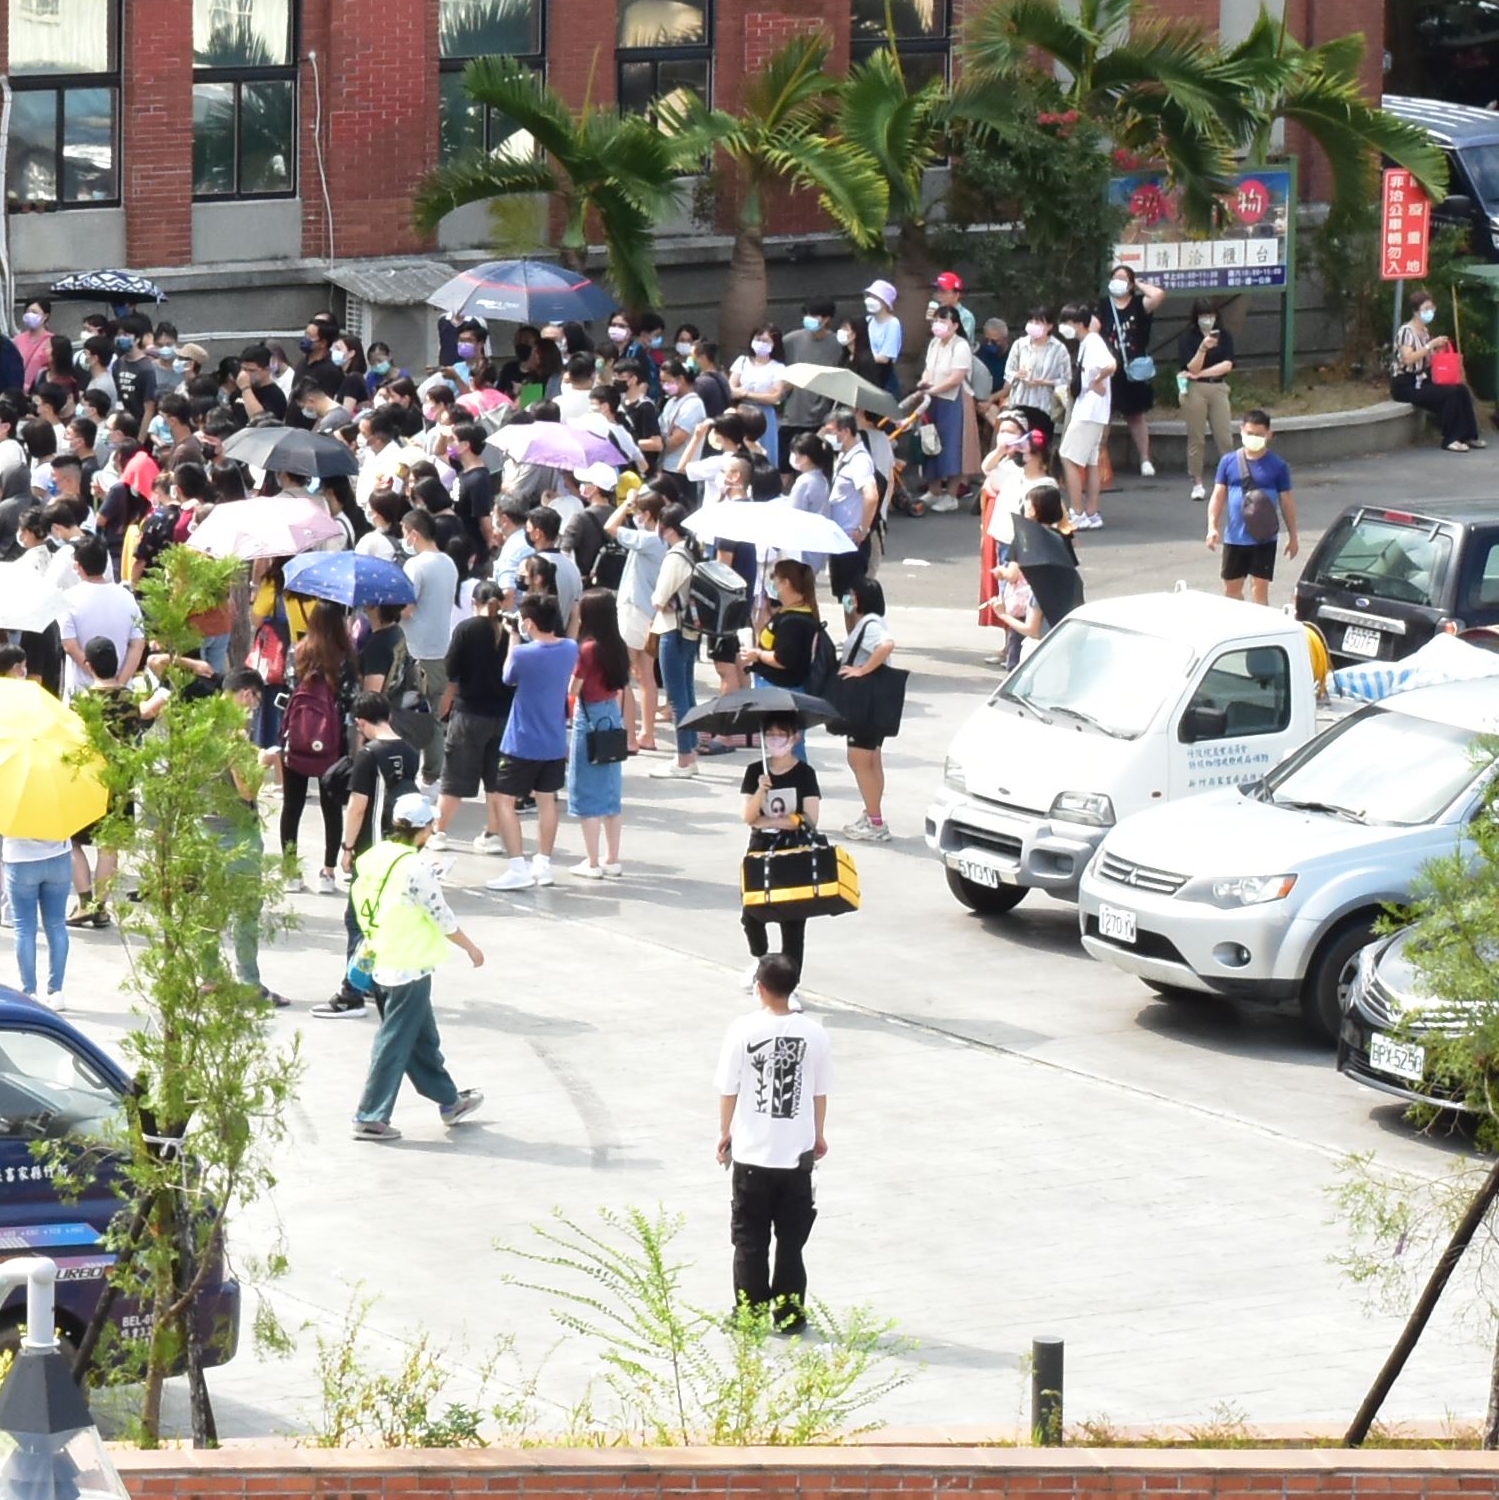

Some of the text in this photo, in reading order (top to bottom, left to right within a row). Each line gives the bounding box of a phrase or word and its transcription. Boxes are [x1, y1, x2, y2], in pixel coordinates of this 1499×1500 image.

[1405, 176, 1424, 273] 疫重地
[1155, 245, 1269, 269] 請洽櫃台
[51, 1267, 103, 1281] URBO
